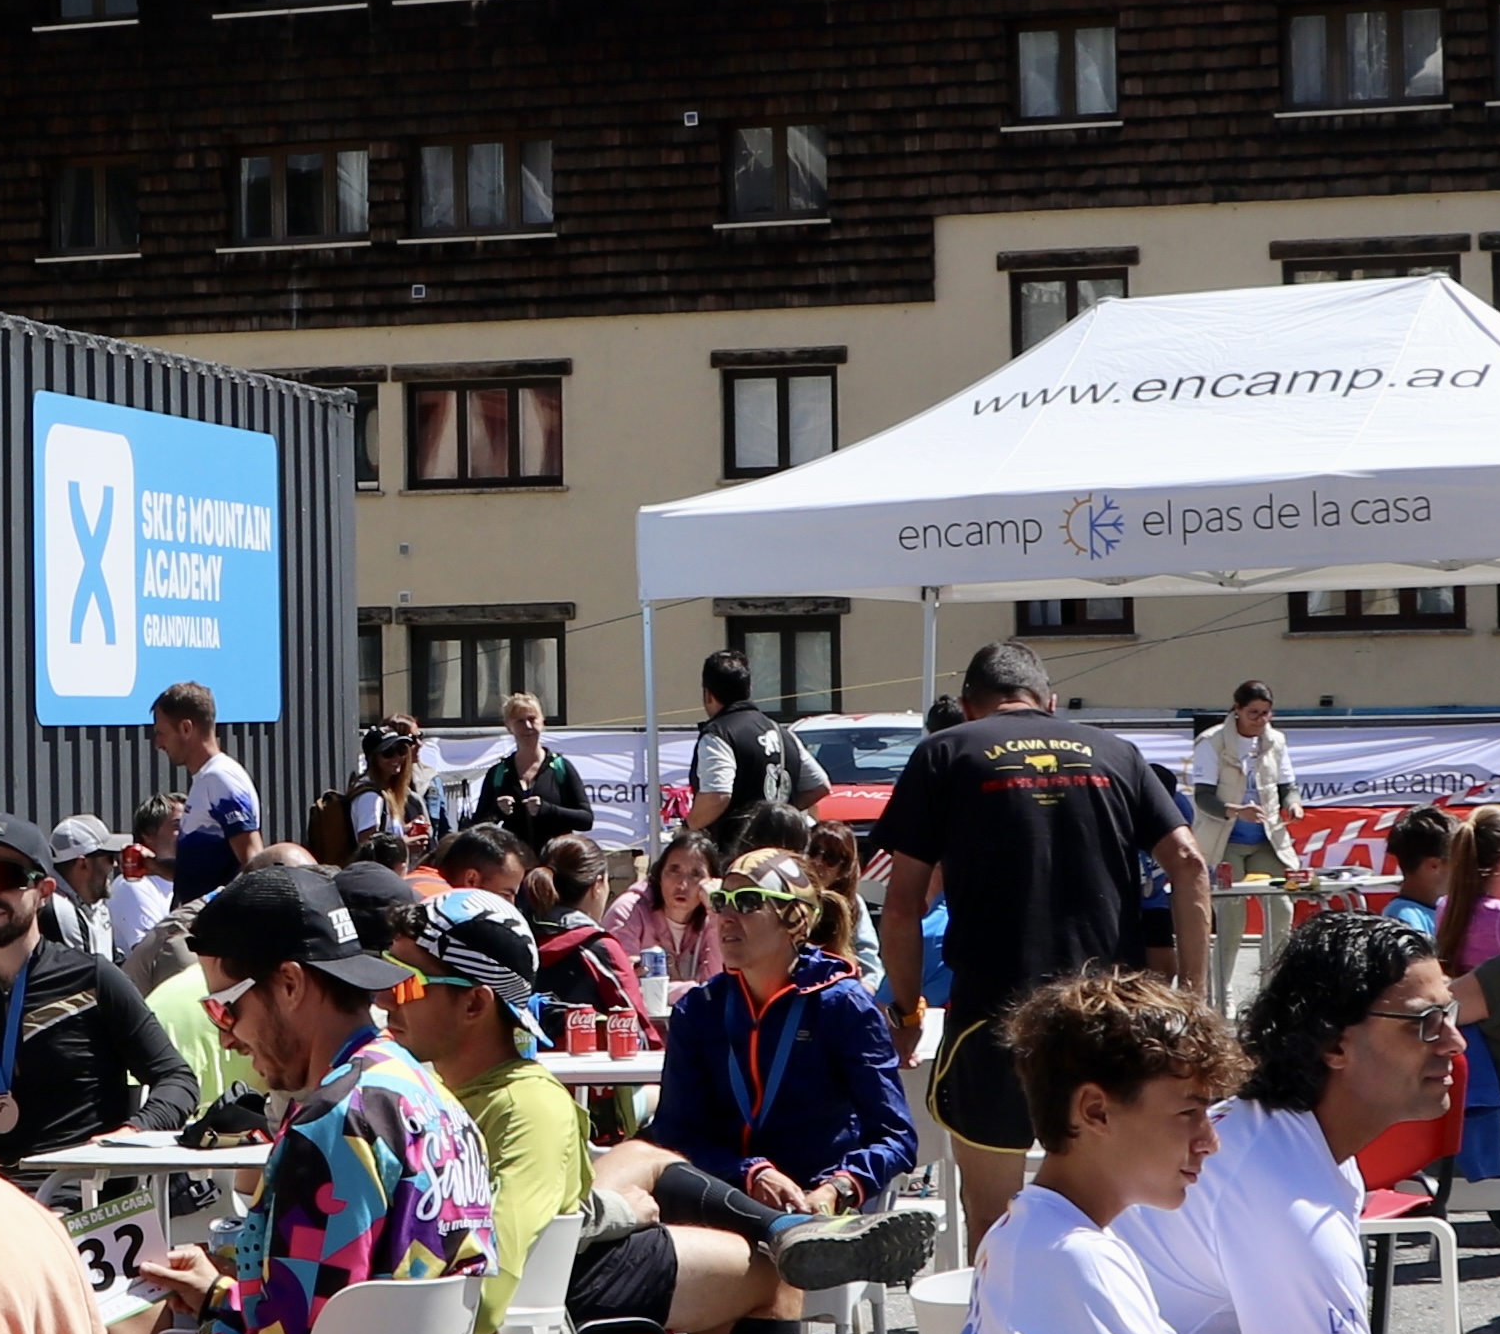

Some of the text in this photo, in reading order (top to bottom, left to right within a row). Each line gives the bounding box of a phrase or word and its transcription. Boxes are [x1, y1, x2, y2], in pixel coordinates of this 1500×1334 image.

[972, 364, 1492, 419] www.encamp.ad
[142, 490, 271, 552] SKI & MOUNTAIN
[898, 516, 1042, 556] encamp
[1142, 490, 1432, 545] el pas de la casa
[143, 548, 222, 602] ACADEMY
[143, 613, 221, 649] GRANDVALIRA
[984, 739, 1094, 761] LA CAVA ROCA
[67, 1192, 153, 1233] PAS DE LA CASA
